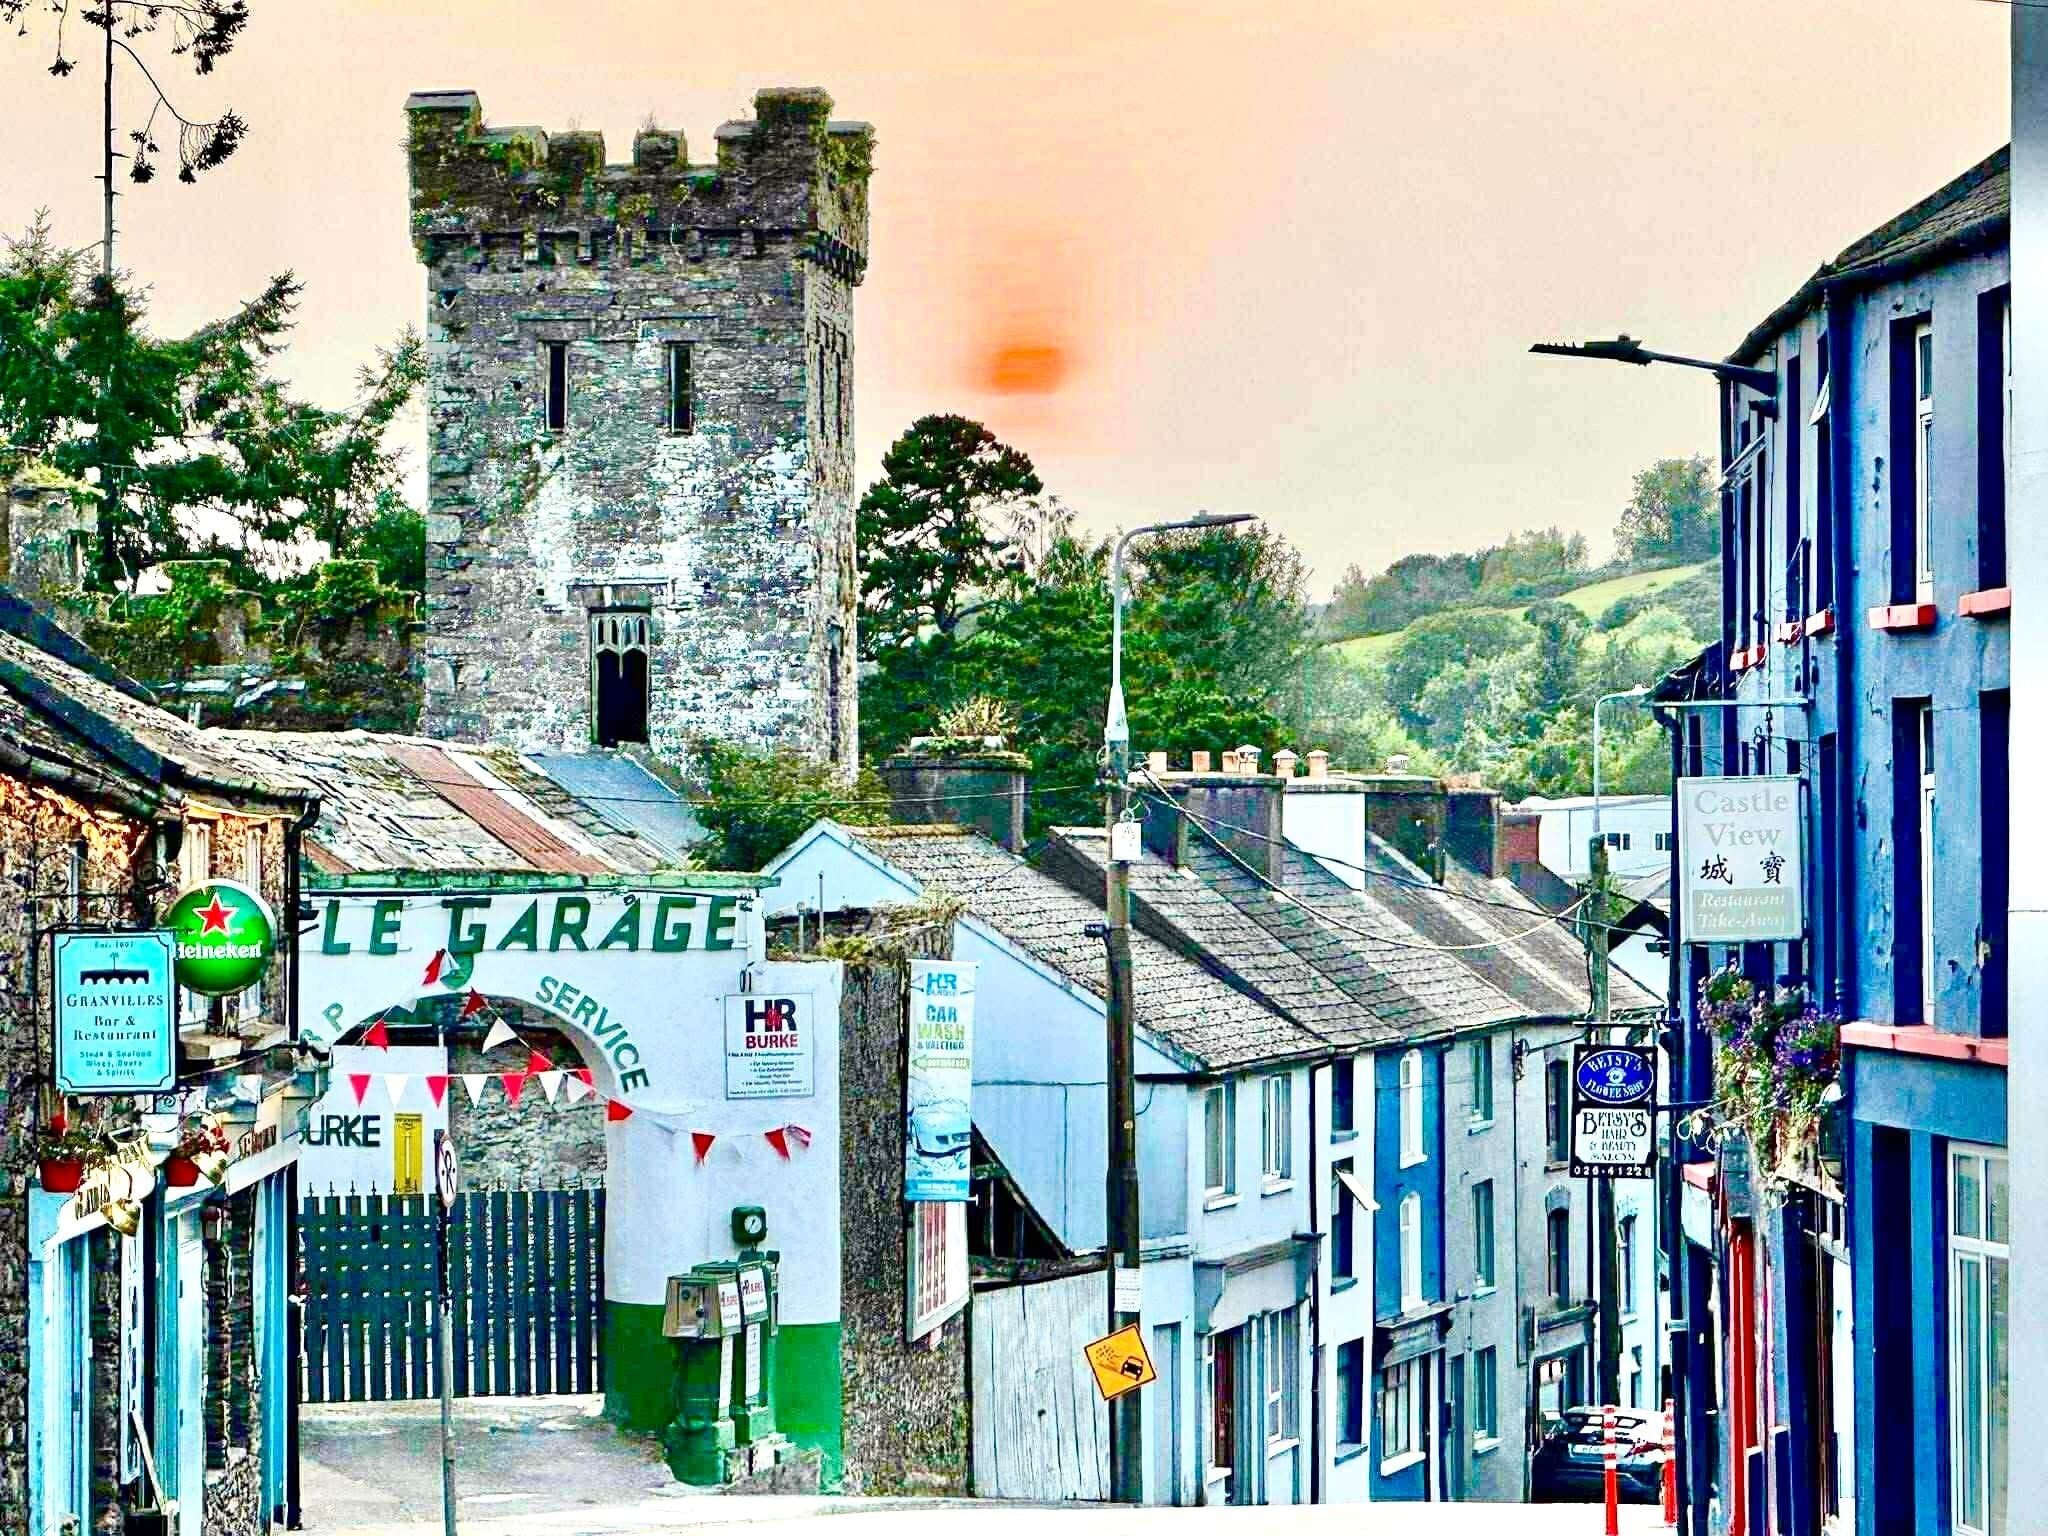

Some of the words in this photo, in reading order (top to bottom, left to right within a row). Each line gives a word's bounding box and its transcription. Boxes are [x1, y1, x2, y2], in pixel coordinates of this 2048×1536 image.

[1695, 788, 1789, 815] Castle
[1704, 822, 1782, 847] View
[1701, 892, 1785, 908] Restaurant
[441, 896, 737, 955] GARAGE
[1697, 914, 1784, 930] Take-Away
[927, 973, 957, 989] HR
[66, 994, 164, 1007] GRANVILLES
[94, 1016, 120, 1027] Bar
[126, 1016, 136, 1026] &
[745, 999, 797, 1032] HR
[926, 1005, 957, 1022] CAR
[73, 1030, 156, 1041] Restaurant
[536, 975, 650, 1094] SERVICE
[917, 1023, 965, 1040] WASH
[746, 1034, 798, 1049] BURKE
[1587, 1055, 1642, 1072] BETSY'S
[1623, 1080, 1645, 1097] SHOP
[1583, 1111, 1647, 1137] BETSY'S
[1601, 1127, 1628, 1139] HAIR
[1601, 1141, 1636, 1150] BEAUTY
[1591, 1152, 1635, 1161] SALON
